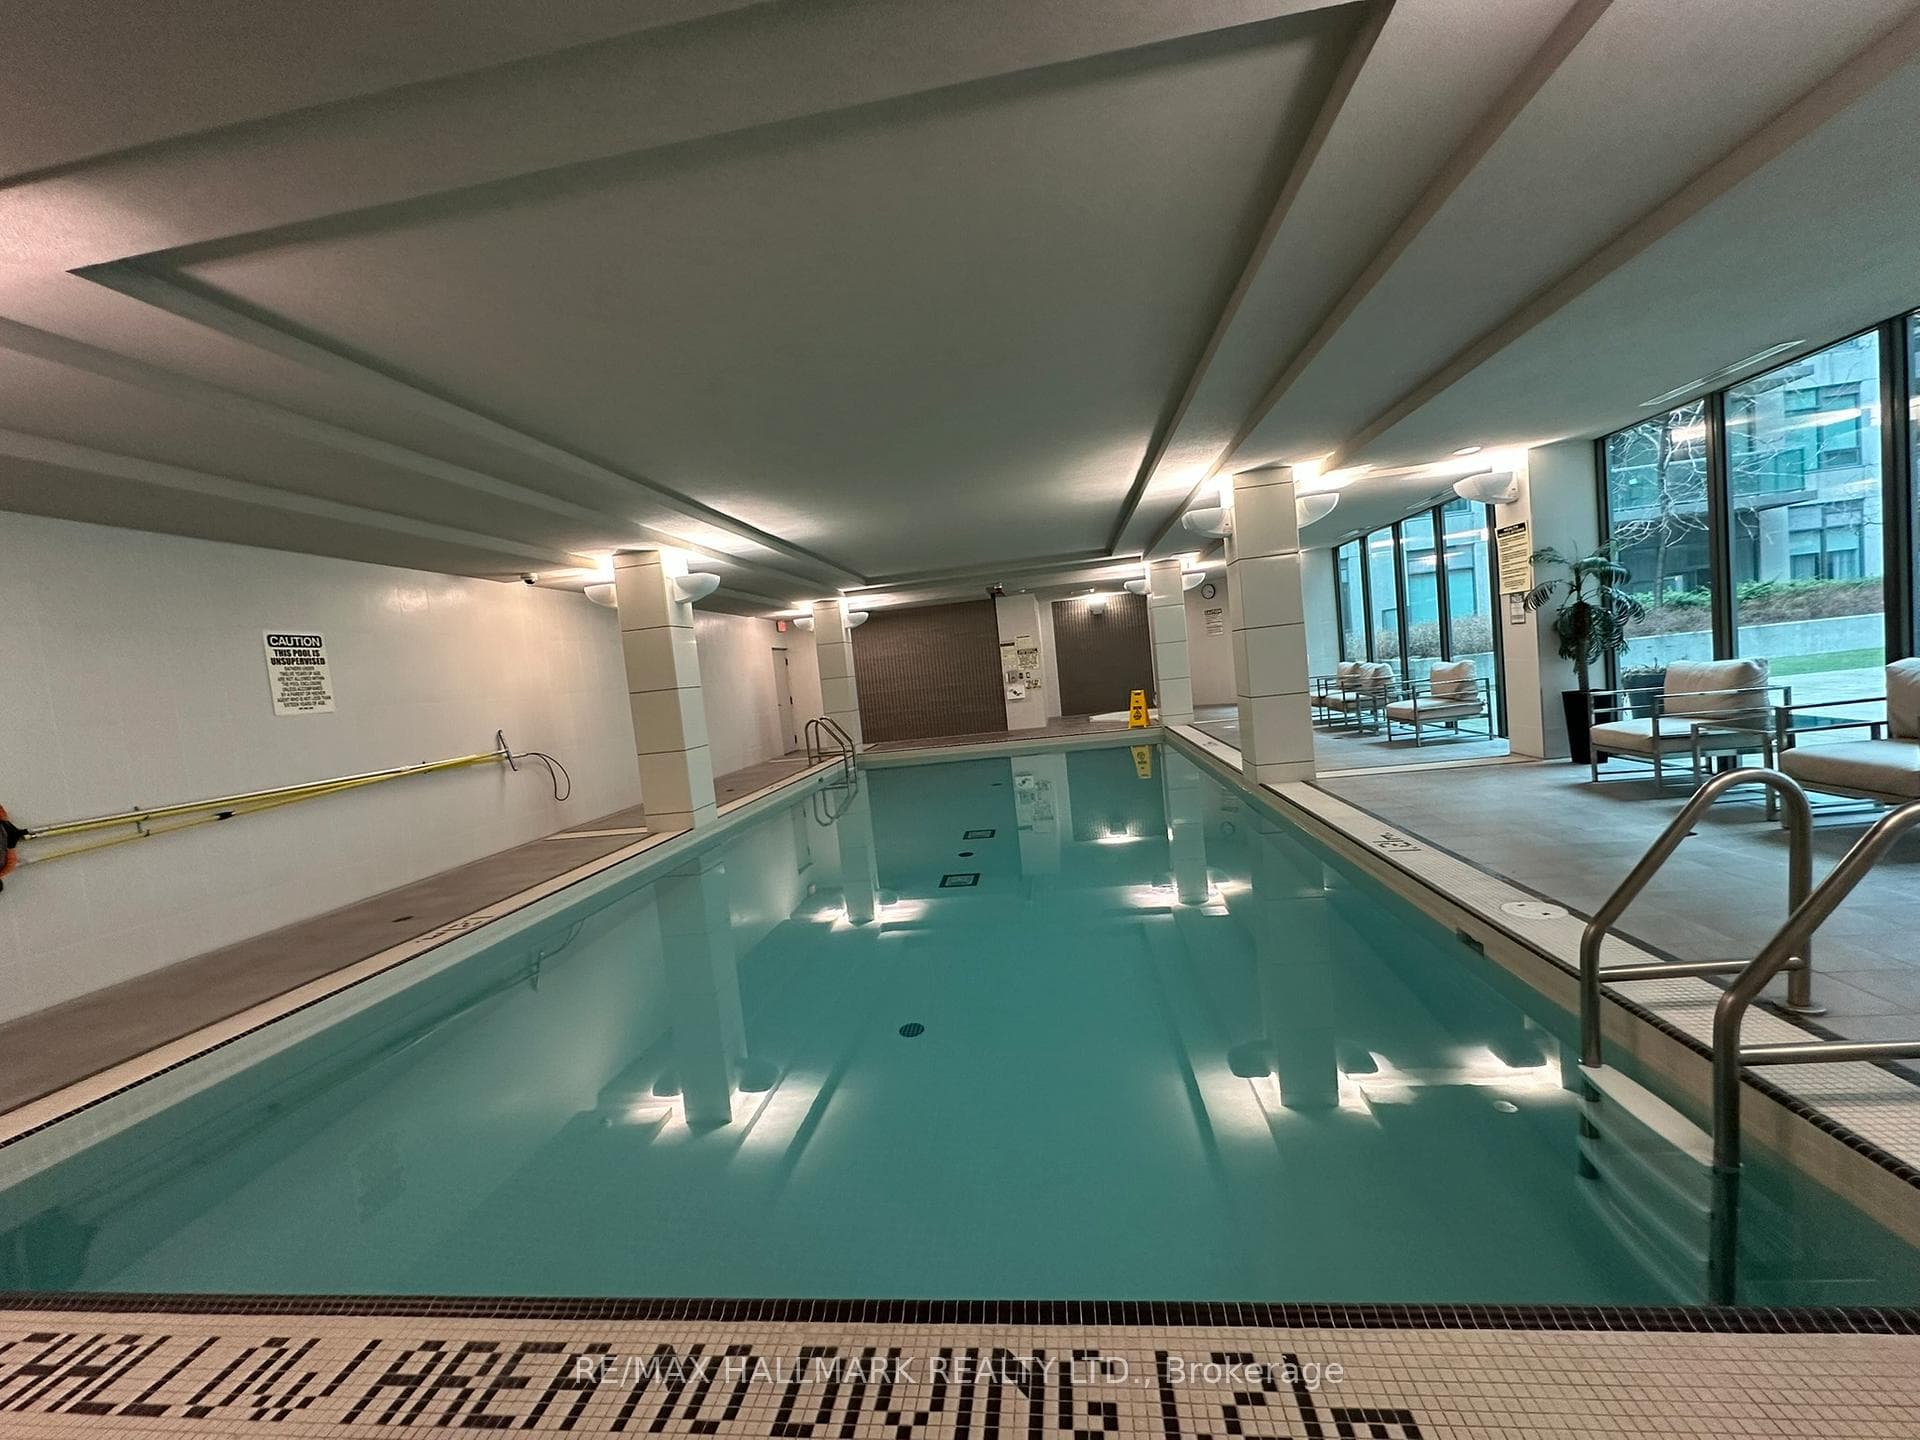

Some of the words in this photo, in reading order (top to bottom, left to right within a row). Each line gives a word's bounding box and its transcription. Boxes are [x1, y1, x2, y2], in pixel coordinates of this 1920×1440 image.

[269, 635, 321, 647] CAUTION
[273, 649, 292, 657] THIS
[293, 649, 311, 657] POOL
[312, 649, 321, 657] IS
[270, 657, 326, 665] UNSUPERVISED
[340, 1340, 618, 1431] AREA
[609, 1343, 759, 1435] NO
[769, 1346, 1119, 1440] DIVING
